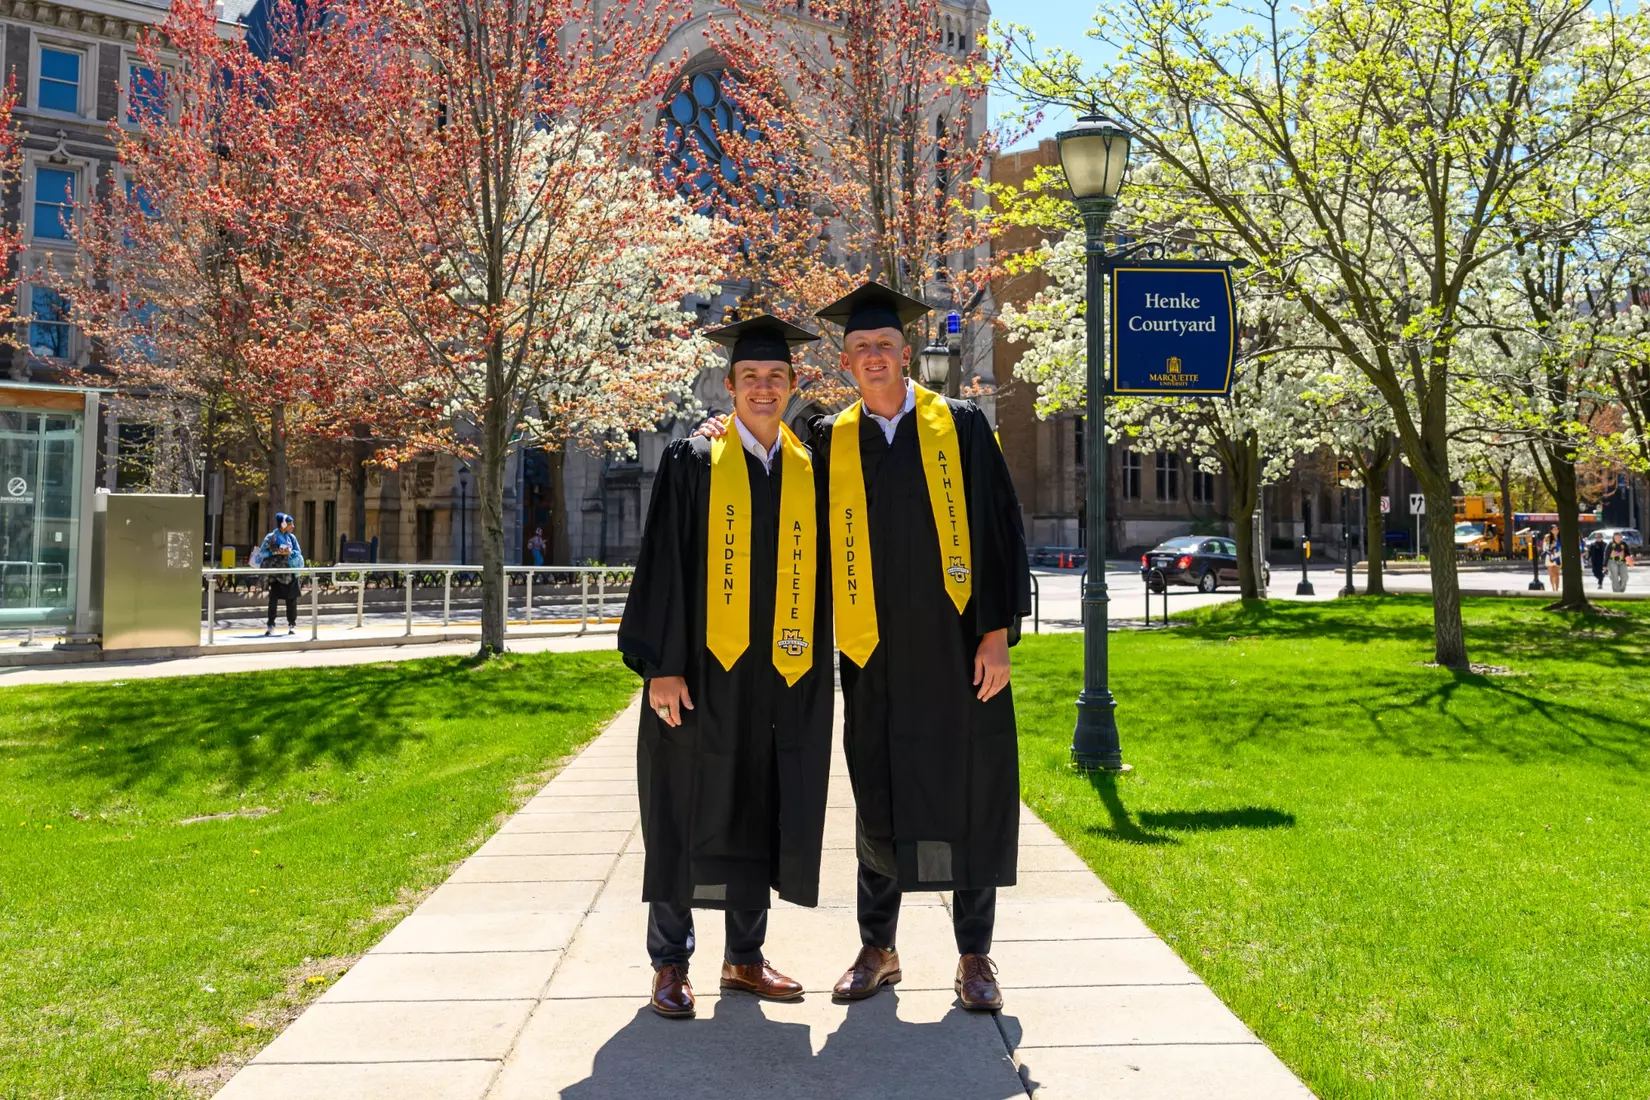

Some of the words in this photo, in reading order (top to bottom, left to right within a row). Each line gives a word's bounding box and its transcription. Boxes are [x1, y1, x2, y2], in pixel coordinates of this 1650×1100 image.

[1128, 316, 1216, 336] Courtyard
[1145, 293, 1200, 309] Henke
[1149, 373, 1199, 382] MARQUETTE
[937, 450, 960, 547] ATHLETE
[724, 504, 735, 605] STUDENT
[791, 520, 802, 620] ATHLETE
[844, 508, 857, 606] STUDENT
